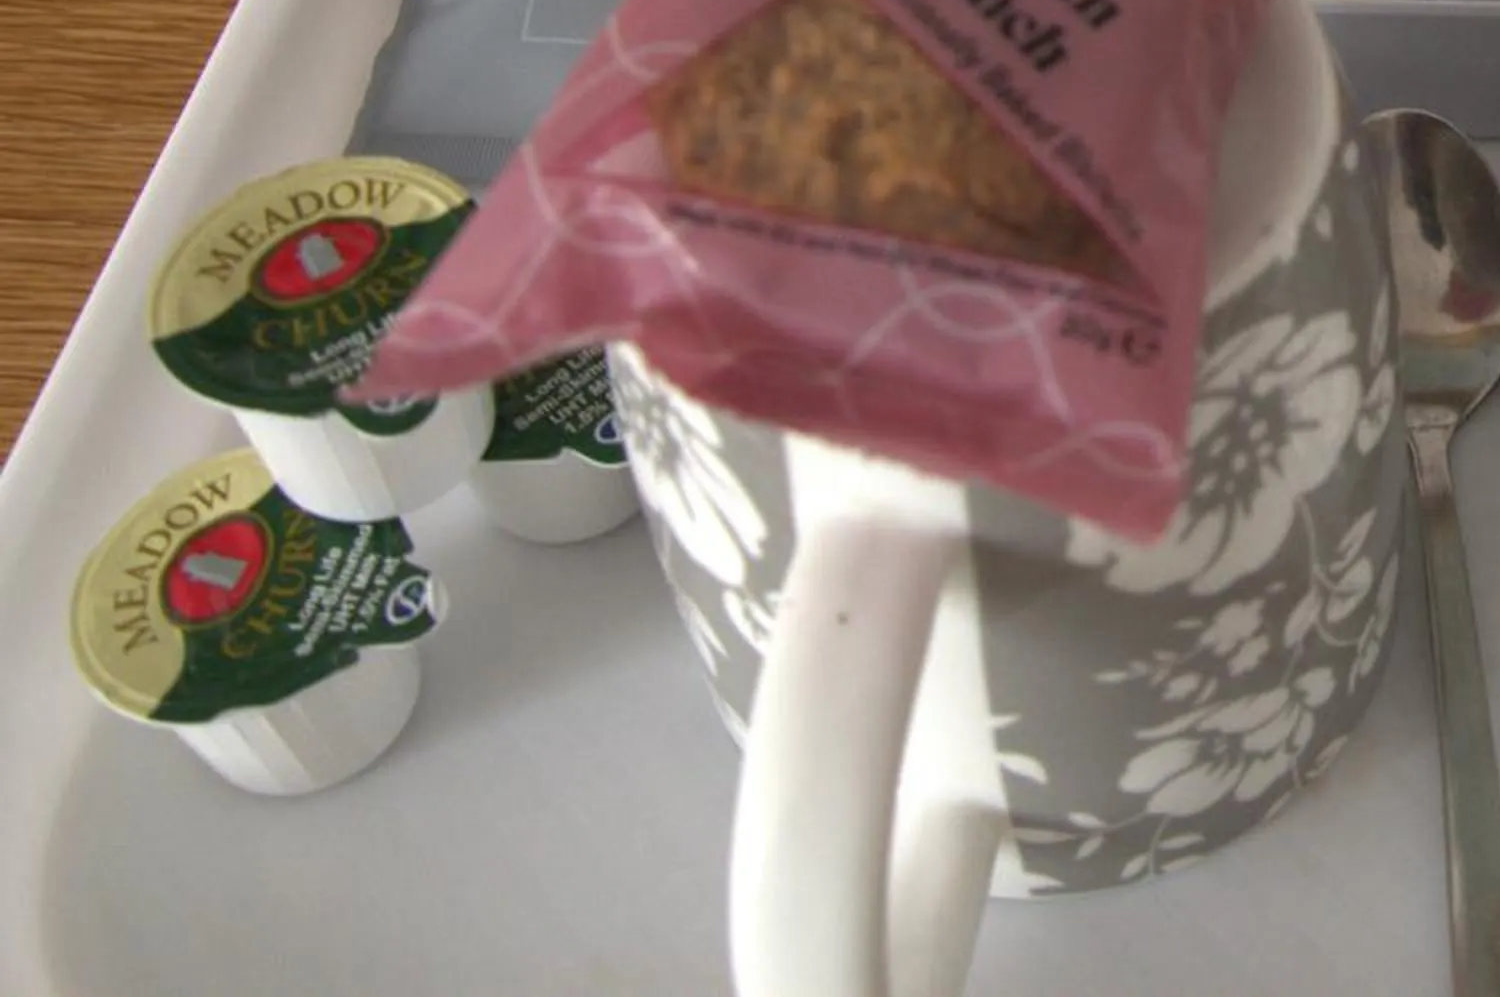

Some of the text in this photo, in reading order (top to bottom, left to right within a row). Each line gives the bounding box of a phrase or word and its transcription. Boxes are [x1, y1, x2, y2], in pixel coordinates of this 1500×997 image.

[195, 177, 406, 285] MEADOW
[252, 250, 428, 350] CHURN
[112, 473, 232, 655] MEADOW
[222, 508, 318, 659] CHURN
[288, 546, 343, 632] Long Life
